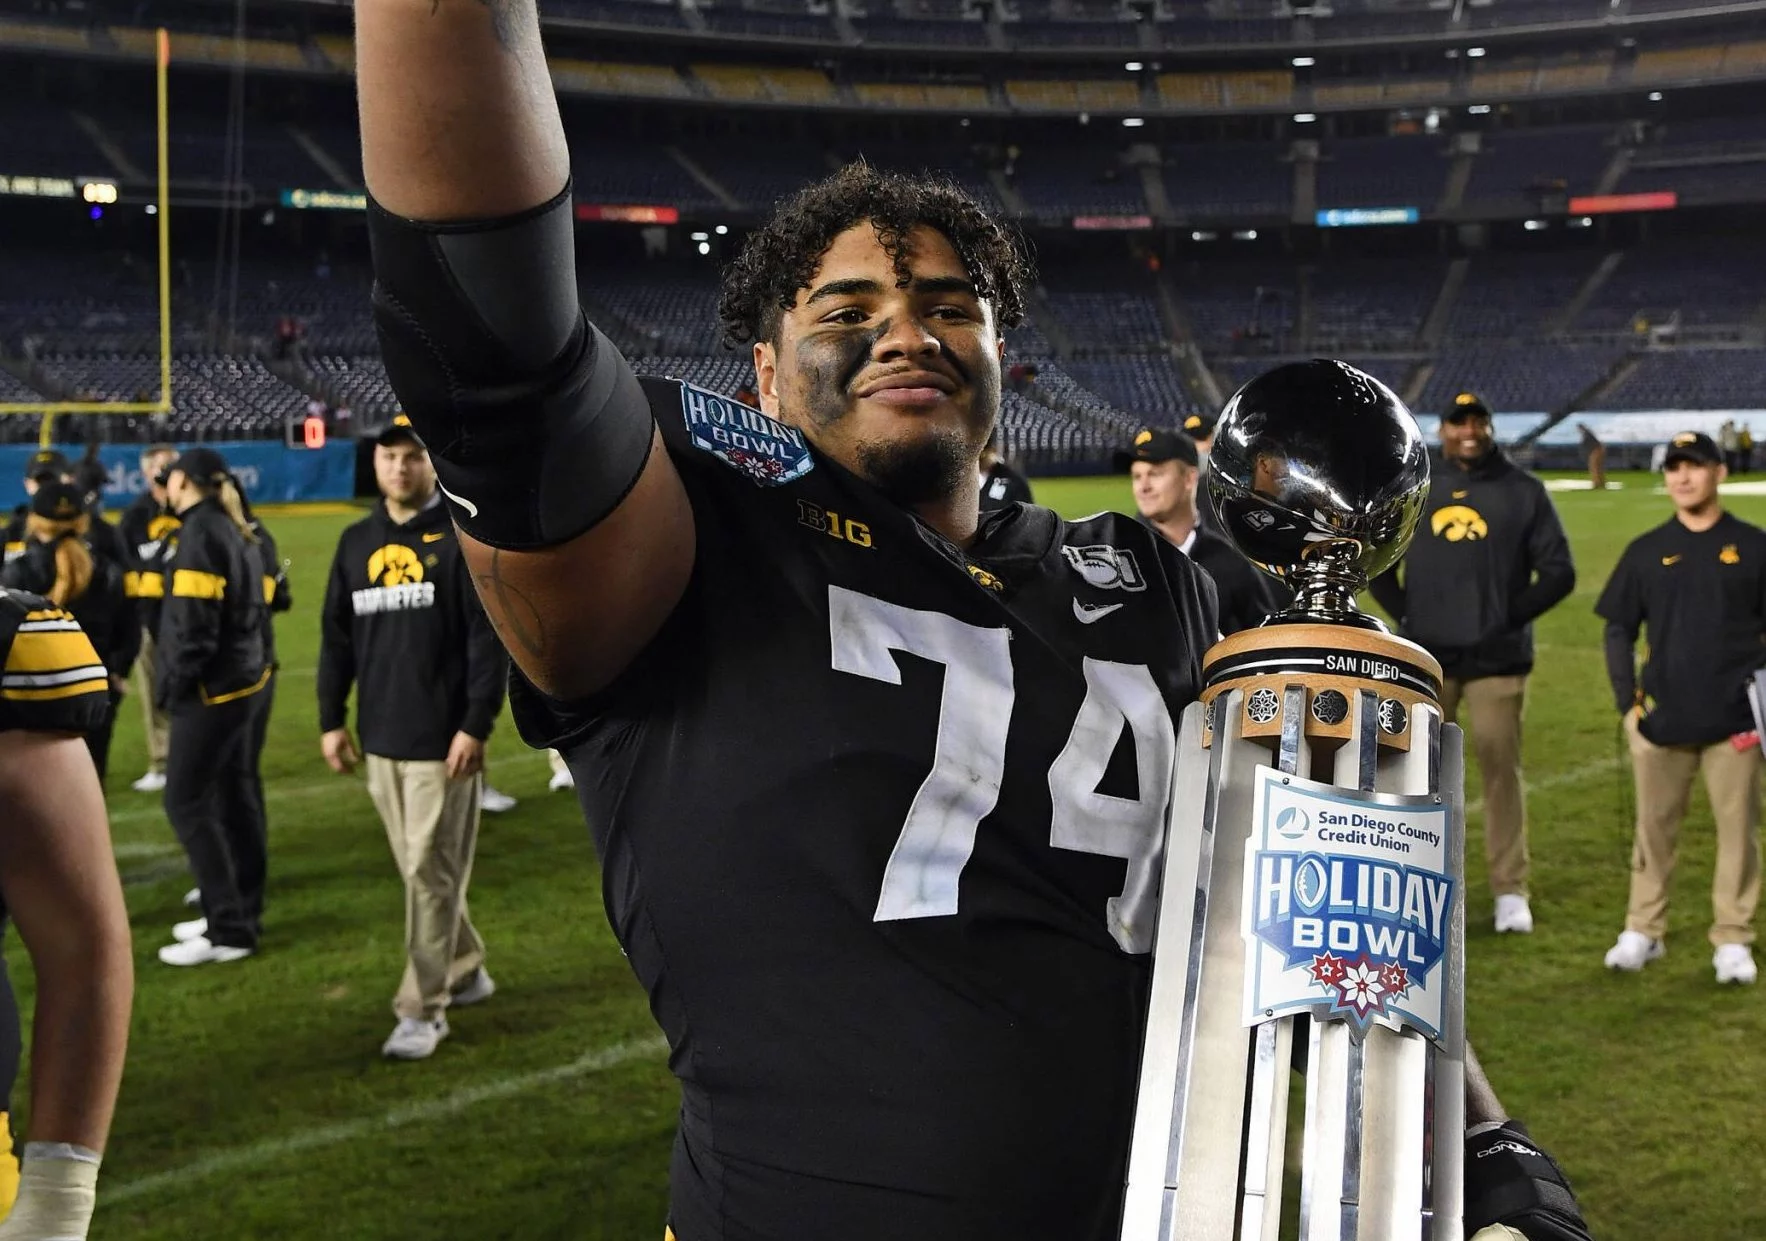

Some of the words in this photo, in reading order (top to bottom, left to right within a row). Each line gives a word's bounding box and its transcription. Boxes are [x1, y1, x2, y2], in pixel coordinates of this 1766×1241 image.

[688, 391, 803, 449] HOLIDAY
[712, 427, 794, 459] BOWL
[1326, 655, 1357, 672] SAN
[1361, 659, 1399, 680] DIEGO
[828, 584, 1175, 954] 74
[1318, 811, 1348, 826] San
[1352, 813, 1396, 834] Diego
[1398, 823, 1440, 848] County
[1318, 828, 1367, 845] Credit
[1370, 836, 1410, 853] Union
[1258, 856, 1448, 940] HOLIDAY
[1292, 916, 1425, 965] BOWL
